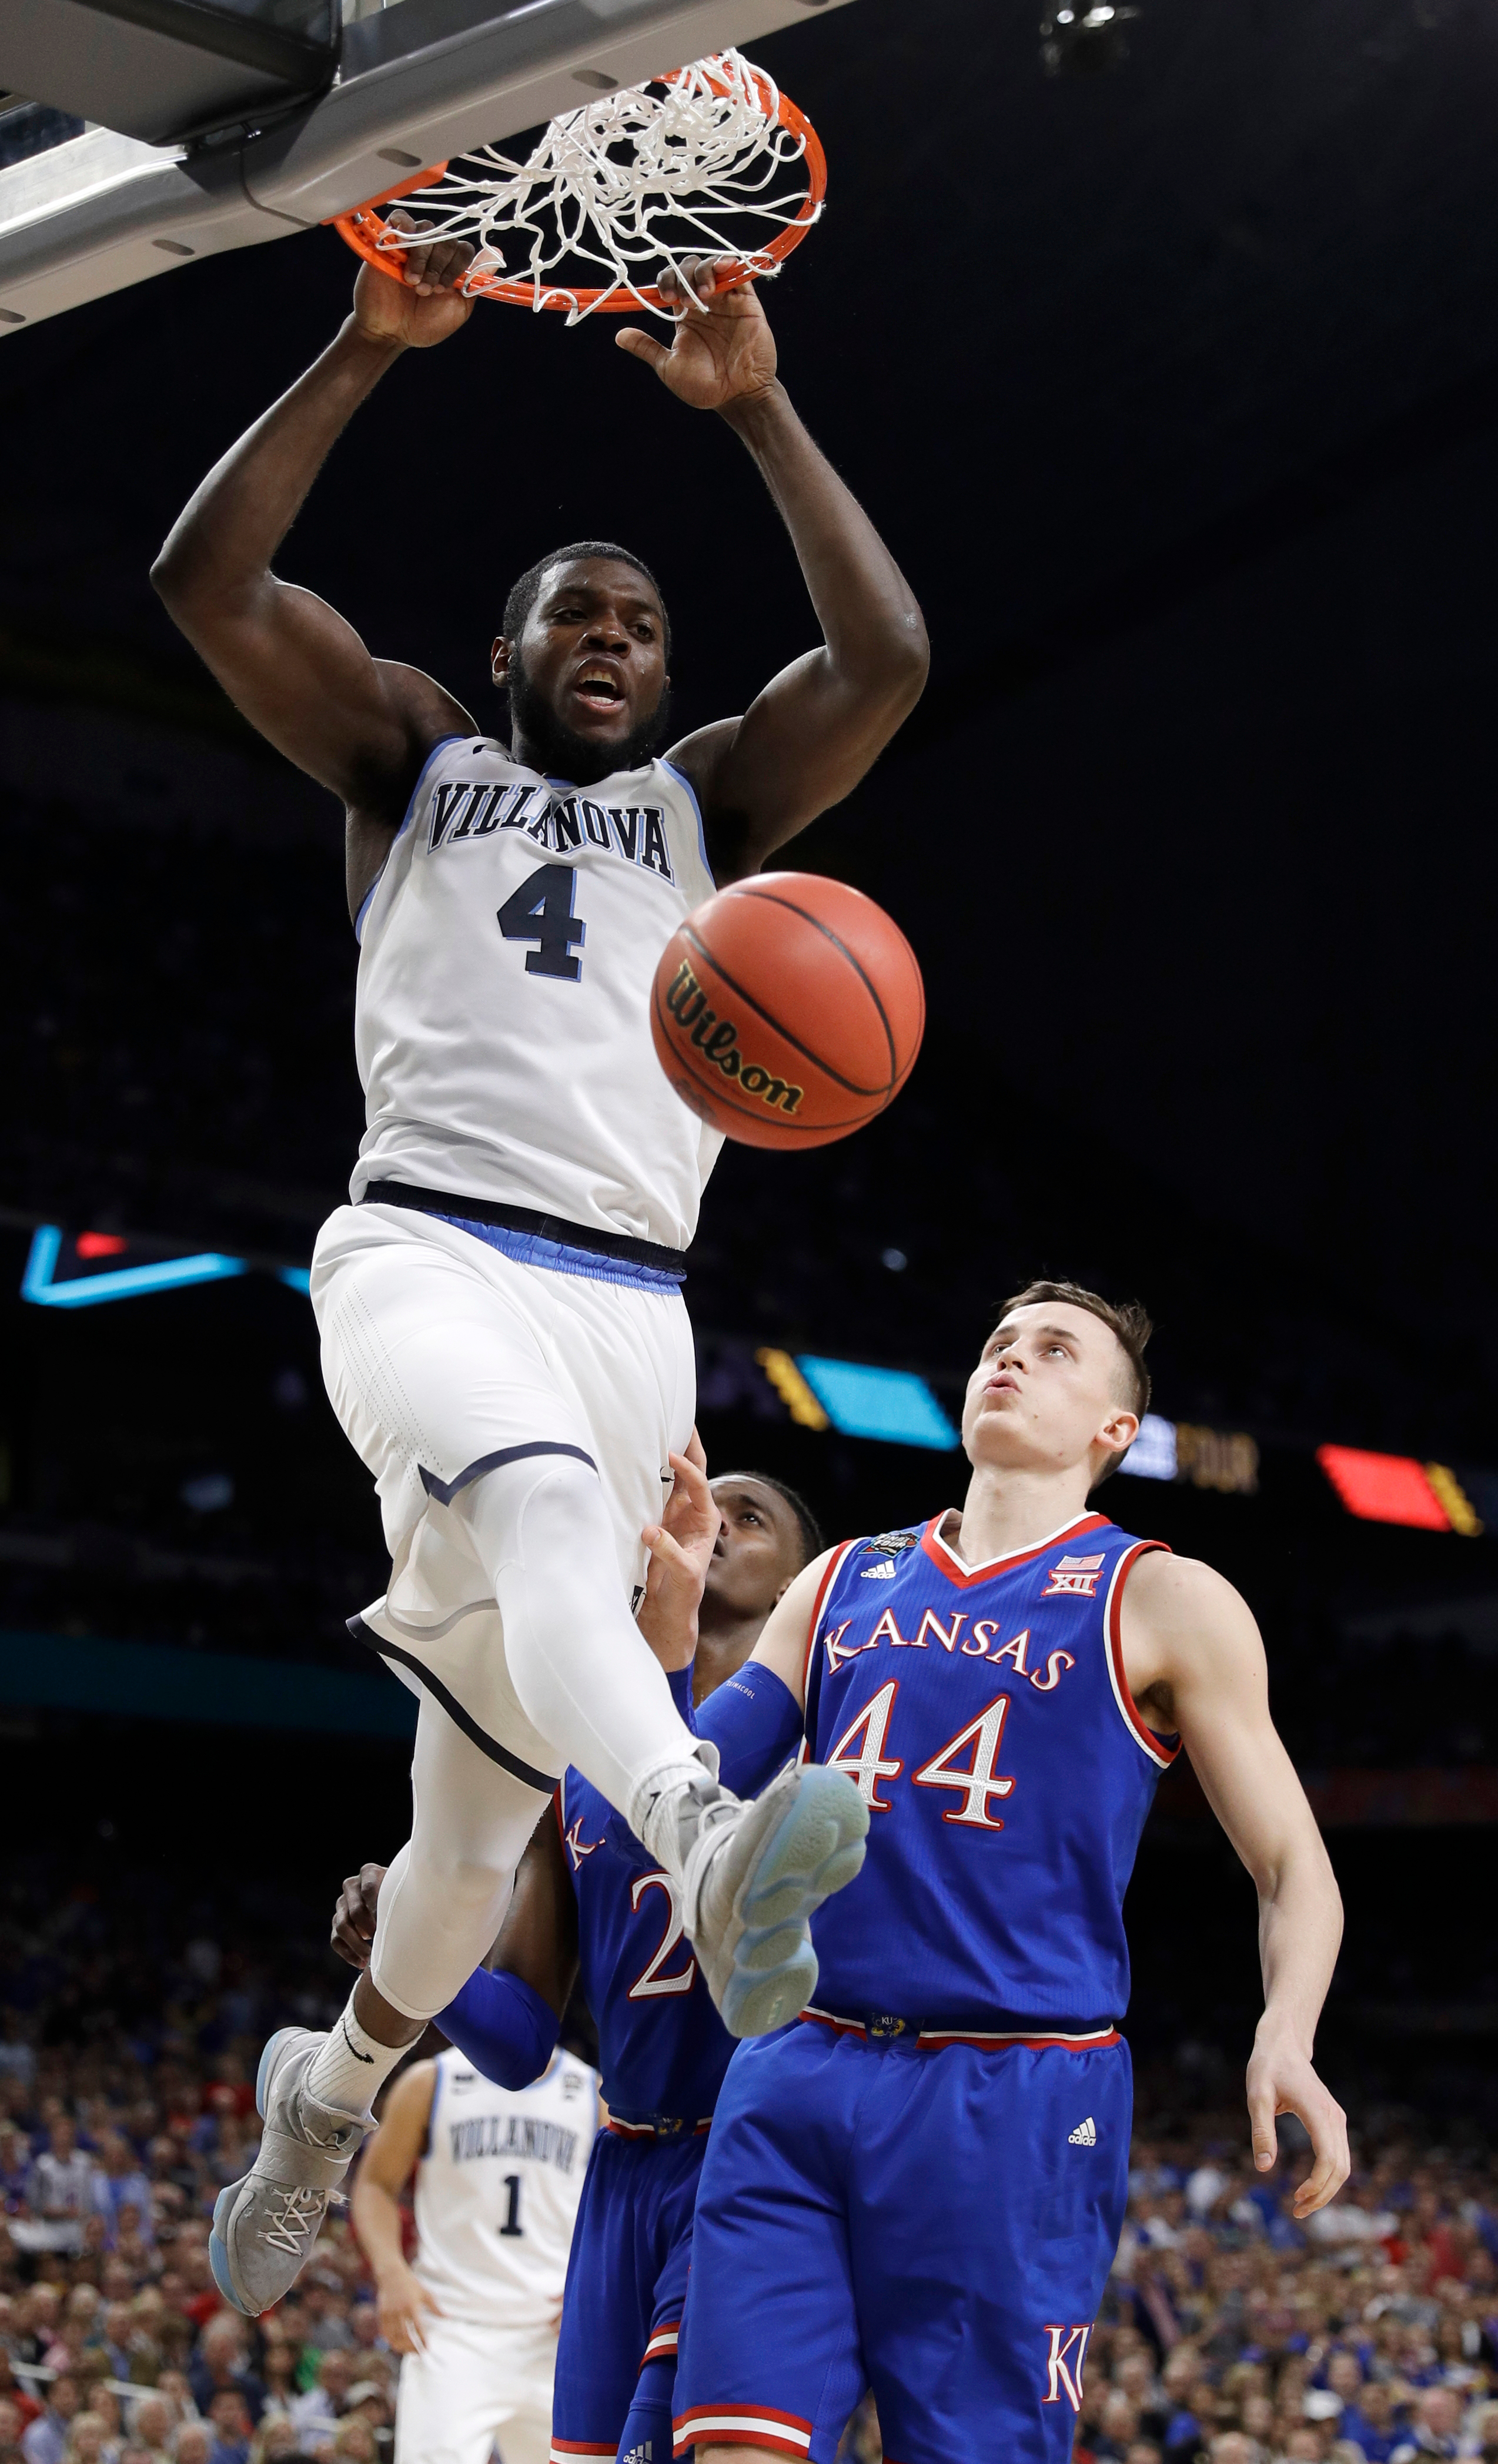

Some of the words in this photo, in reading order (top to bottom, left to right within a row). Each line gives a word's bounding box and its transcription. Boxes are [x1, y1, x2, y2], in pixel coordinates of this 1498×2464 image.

[429, 782, 673, 883] VILLANOVA
[497, 863, 586, 982] 4
[667, 959, 804, 1115] Wilson
[860, 1571, 897, 1579] adida
[823, 1607, 1076, 1692] KANSAS
[826, 1678, 1016, 1832] 44
[881, 2017, 894, 2026] KU
[1068, 2134, 1096, 2147] adida
[500, 2175, 523, 2236] 1
